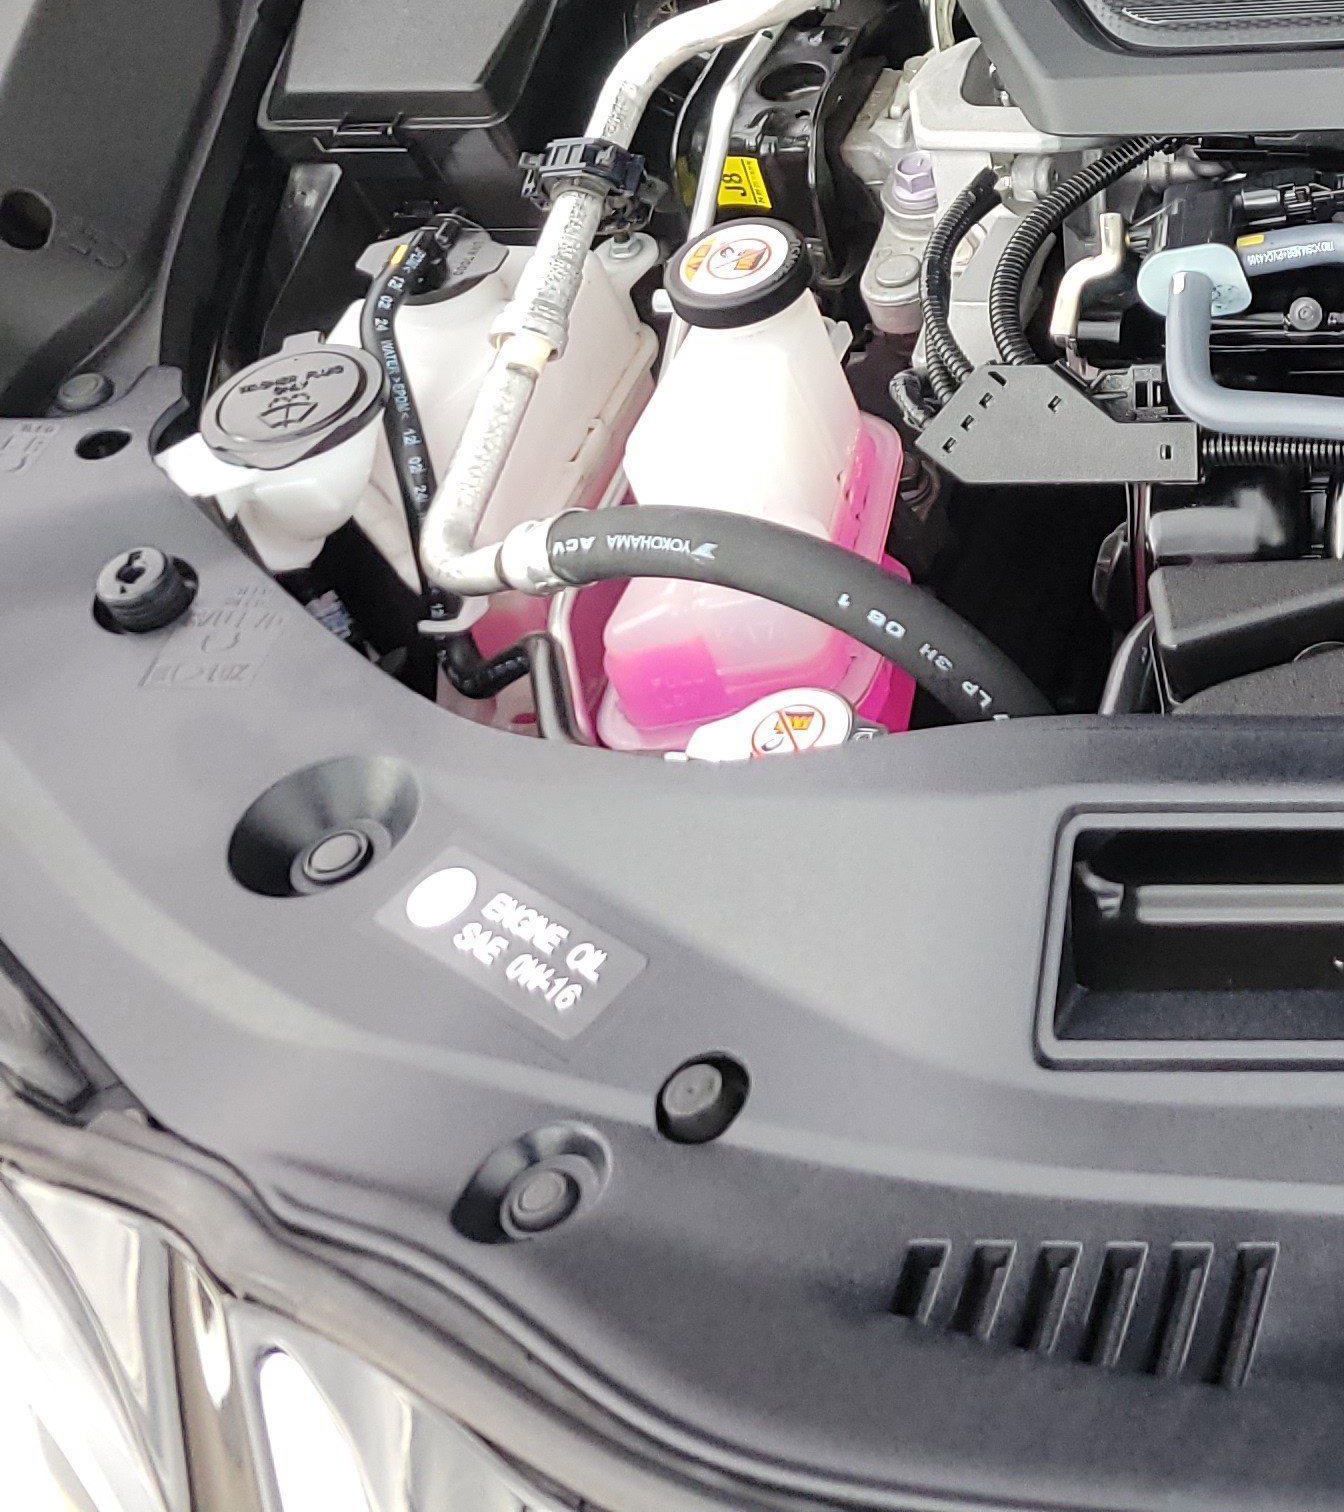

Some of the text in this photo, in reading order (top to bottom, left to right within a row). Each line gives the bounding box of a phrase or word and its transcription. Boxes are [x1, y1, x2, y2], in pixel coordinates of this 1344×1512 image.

[722, 172, 748, 197] J8
[552, 534, 692, 556] YOKOHAMA ACV
[961, 680, 993, 707] LP
[453, 922, 509, 967] SAE
[480, 892, 608, 985] ENGINE OIL
